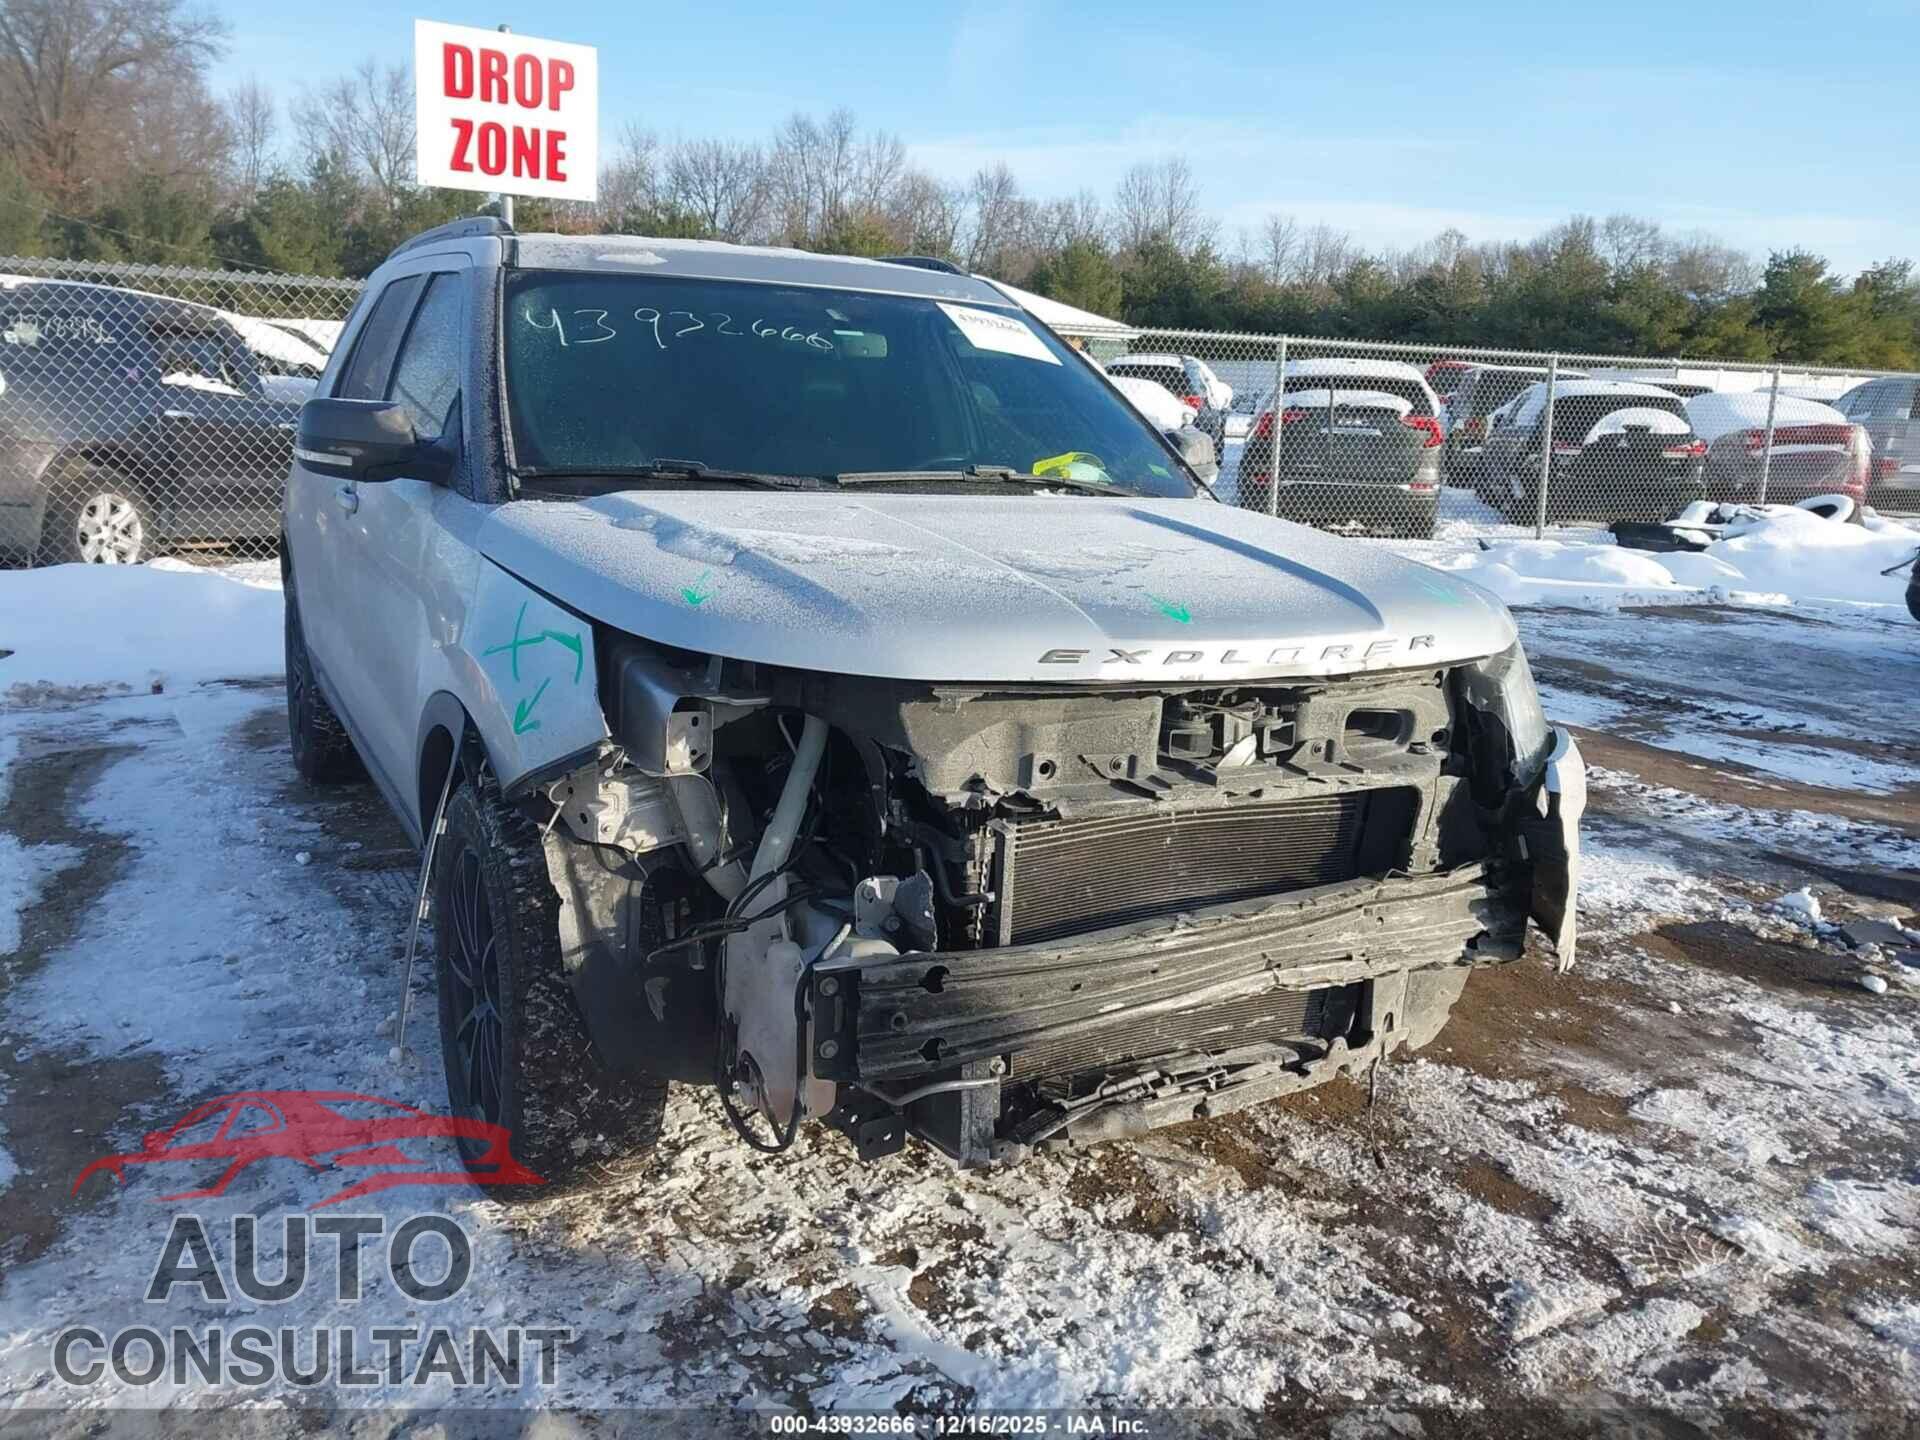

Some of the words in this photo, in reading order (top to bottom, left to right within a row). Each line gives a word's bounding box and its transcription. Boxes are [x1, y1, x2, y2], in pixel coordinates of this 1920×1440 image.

[443, 42, 575, 112] DROP
[450, 118, 567, 182] ZONE
[1036, 634, 1436, 665] EXPLORER
